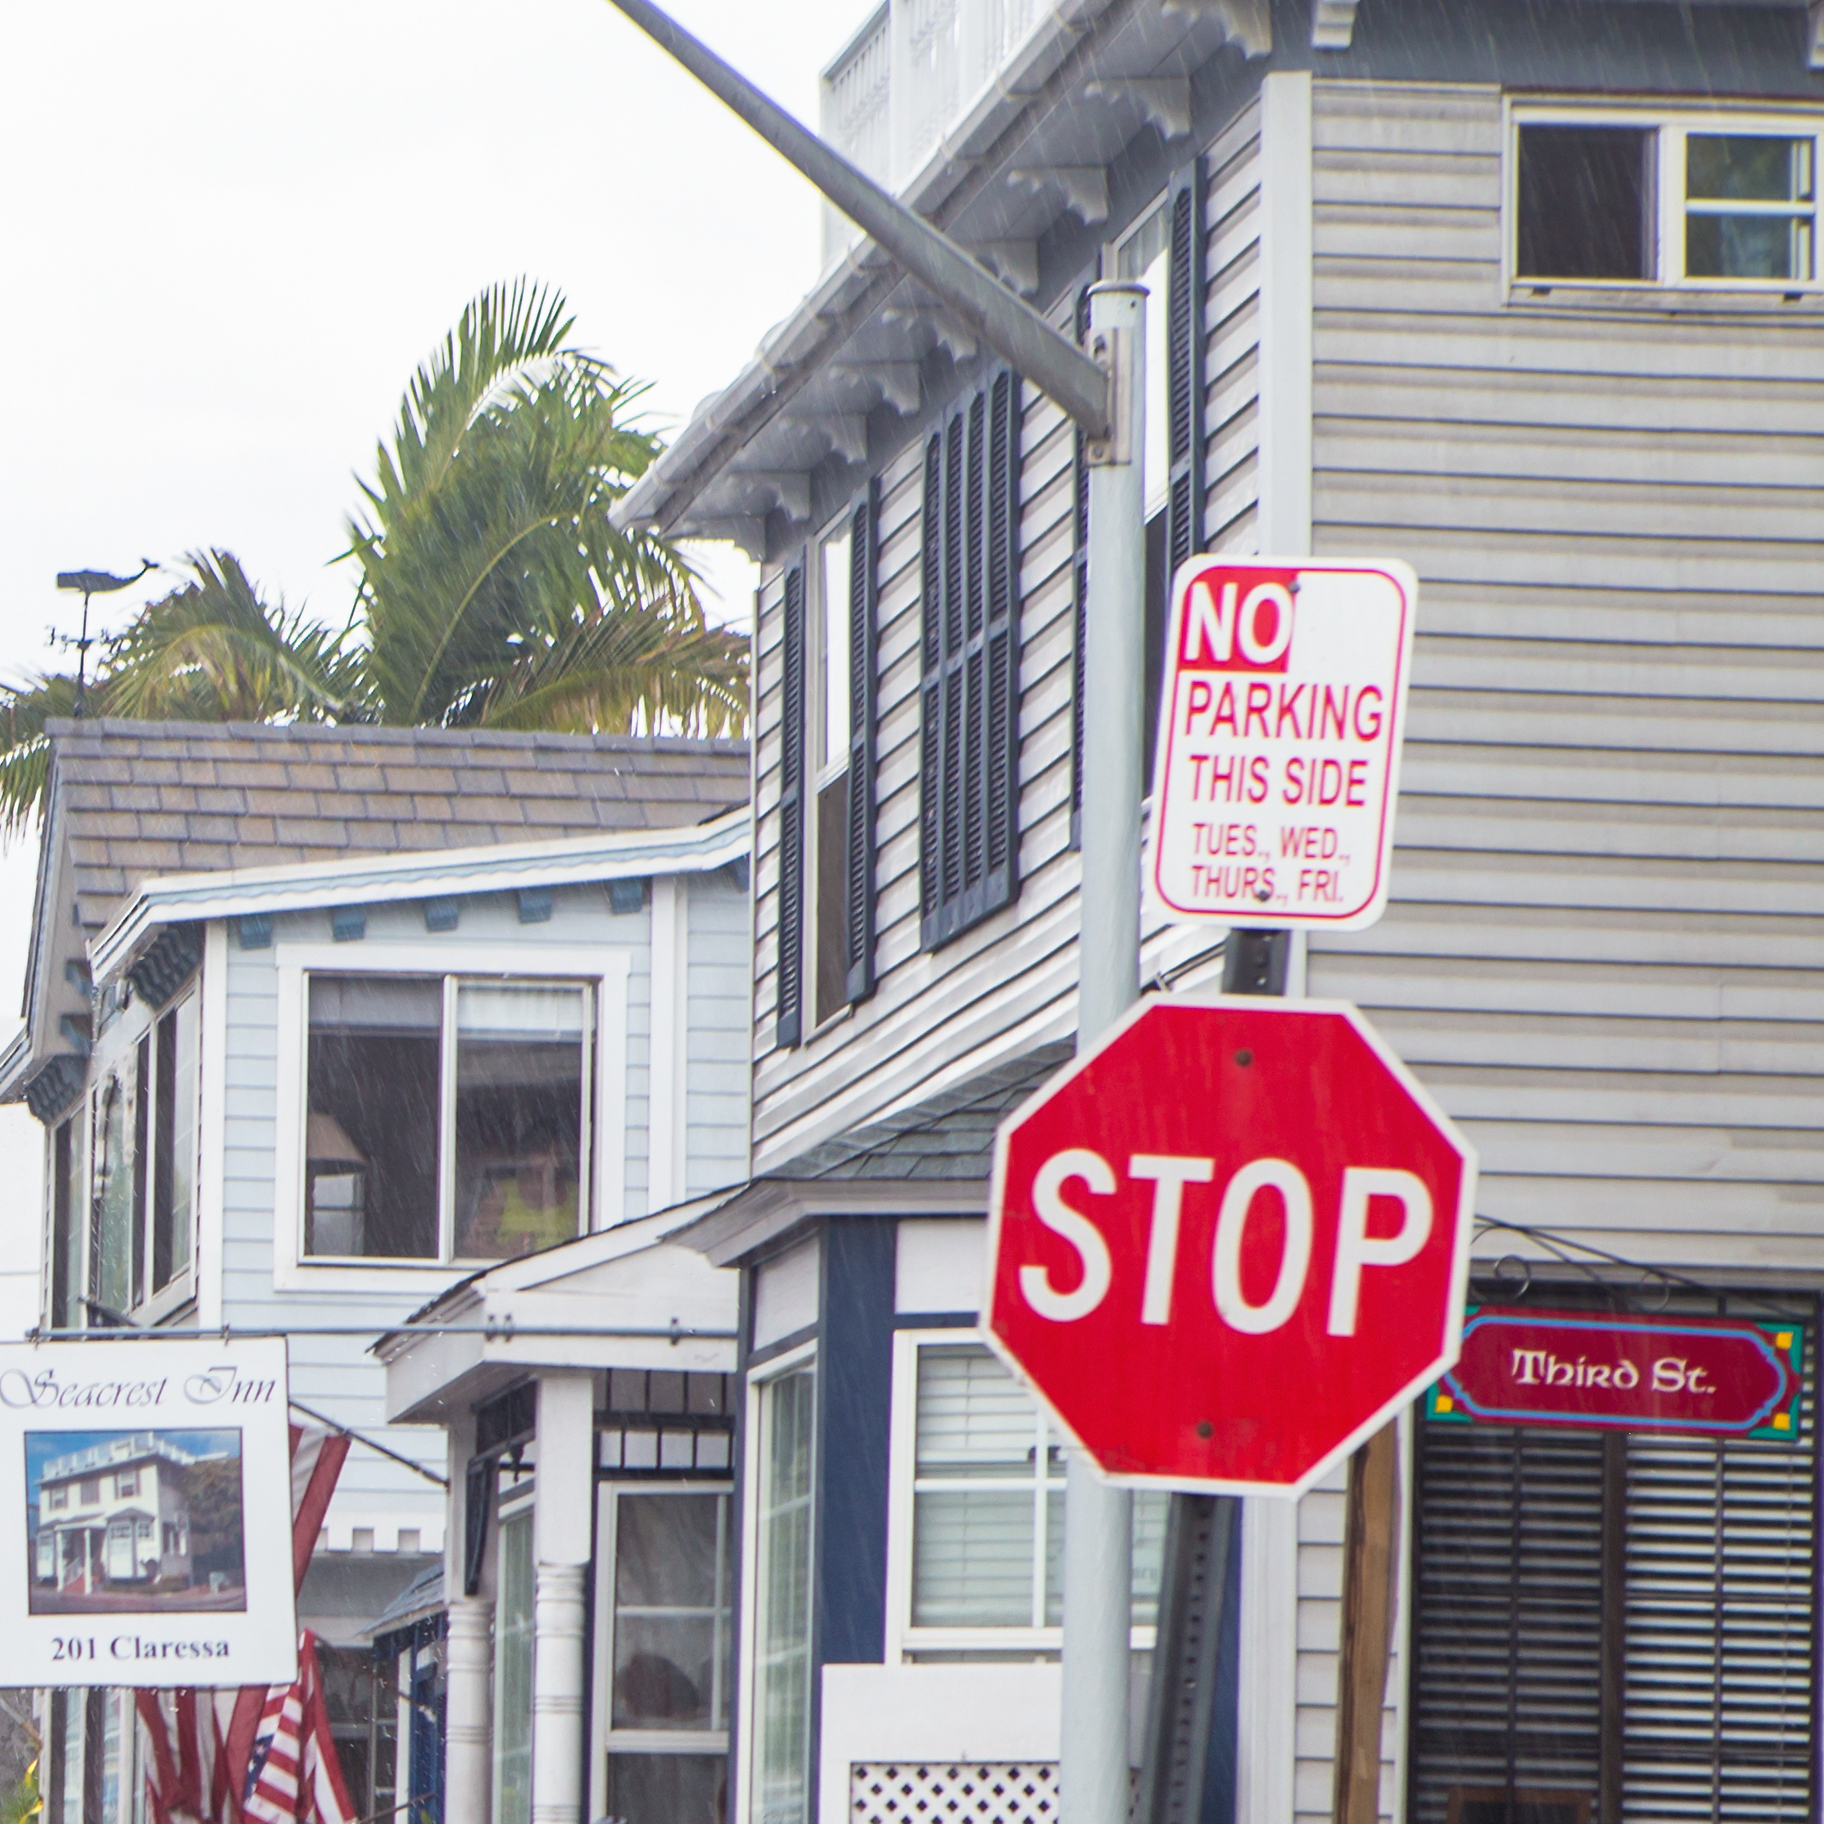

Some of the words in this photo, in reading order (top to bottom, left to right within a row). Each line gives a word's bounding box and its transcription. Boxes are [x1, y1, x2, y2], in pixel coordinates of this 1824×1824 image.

[1185, 581, 1294, 664] NO
[1184, 680, 1384, 741] PARKING
[1189, 754, 1270, 804] THIS
[1282, 756, 1369, 807] SIDE
[1297, 869, 1344, 903] FRI.
[1018, 1147, 1434, 1338] STOP
[183, 1365, 276, 1405] Inn
[1511, 1347, 1640, 1390] Third
[1652, 1356, 1717, 1394] St.
[51, 1636, 95, 1661] 201
[109, 1635, 230, 1661] Claressa
